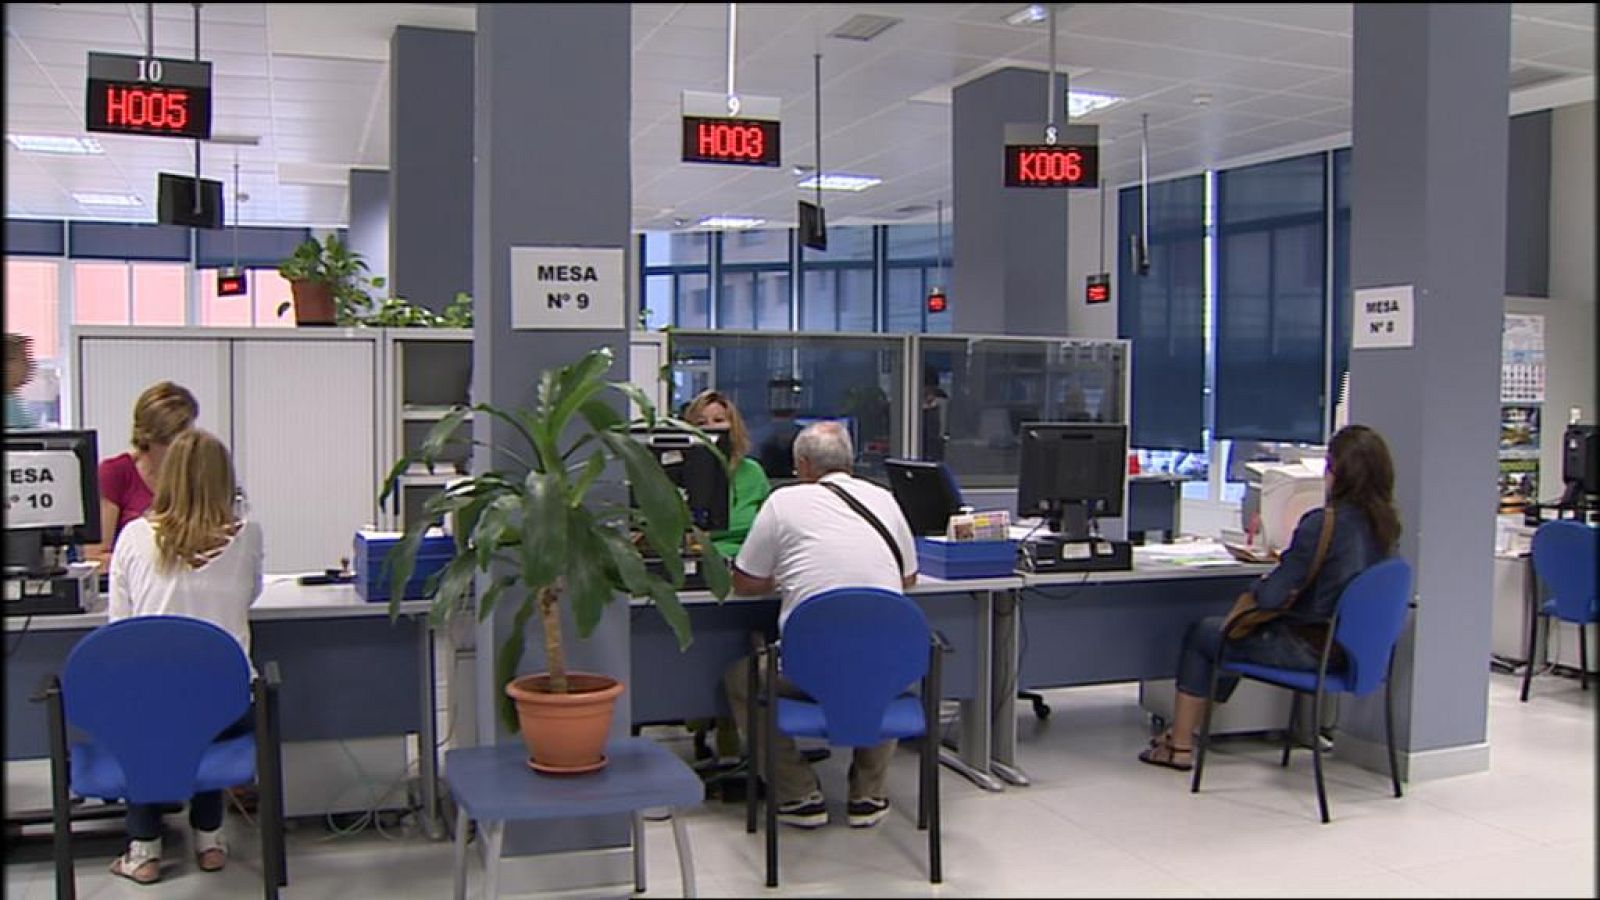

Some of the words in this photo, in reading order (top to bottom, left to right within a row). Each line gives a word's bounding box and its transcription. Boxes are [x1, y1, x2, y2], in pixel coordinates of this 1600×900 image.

[137, 60, 162, 82] 10
[106, 86, 188, 129] H005
[728, 96, 740, 117] 9
[699, 123, 764, 158] H003
[1046, 126, 1058, 146] 8
[1019, 152, 1083, 181] K006
[537, 264, 599, 282] MESA
[577, 292, 591, 310] 9
[1366, 300, 1400, 315] MESA
[7, 468, 54, 484] ESA
[27, 493, 54, 509] 10
